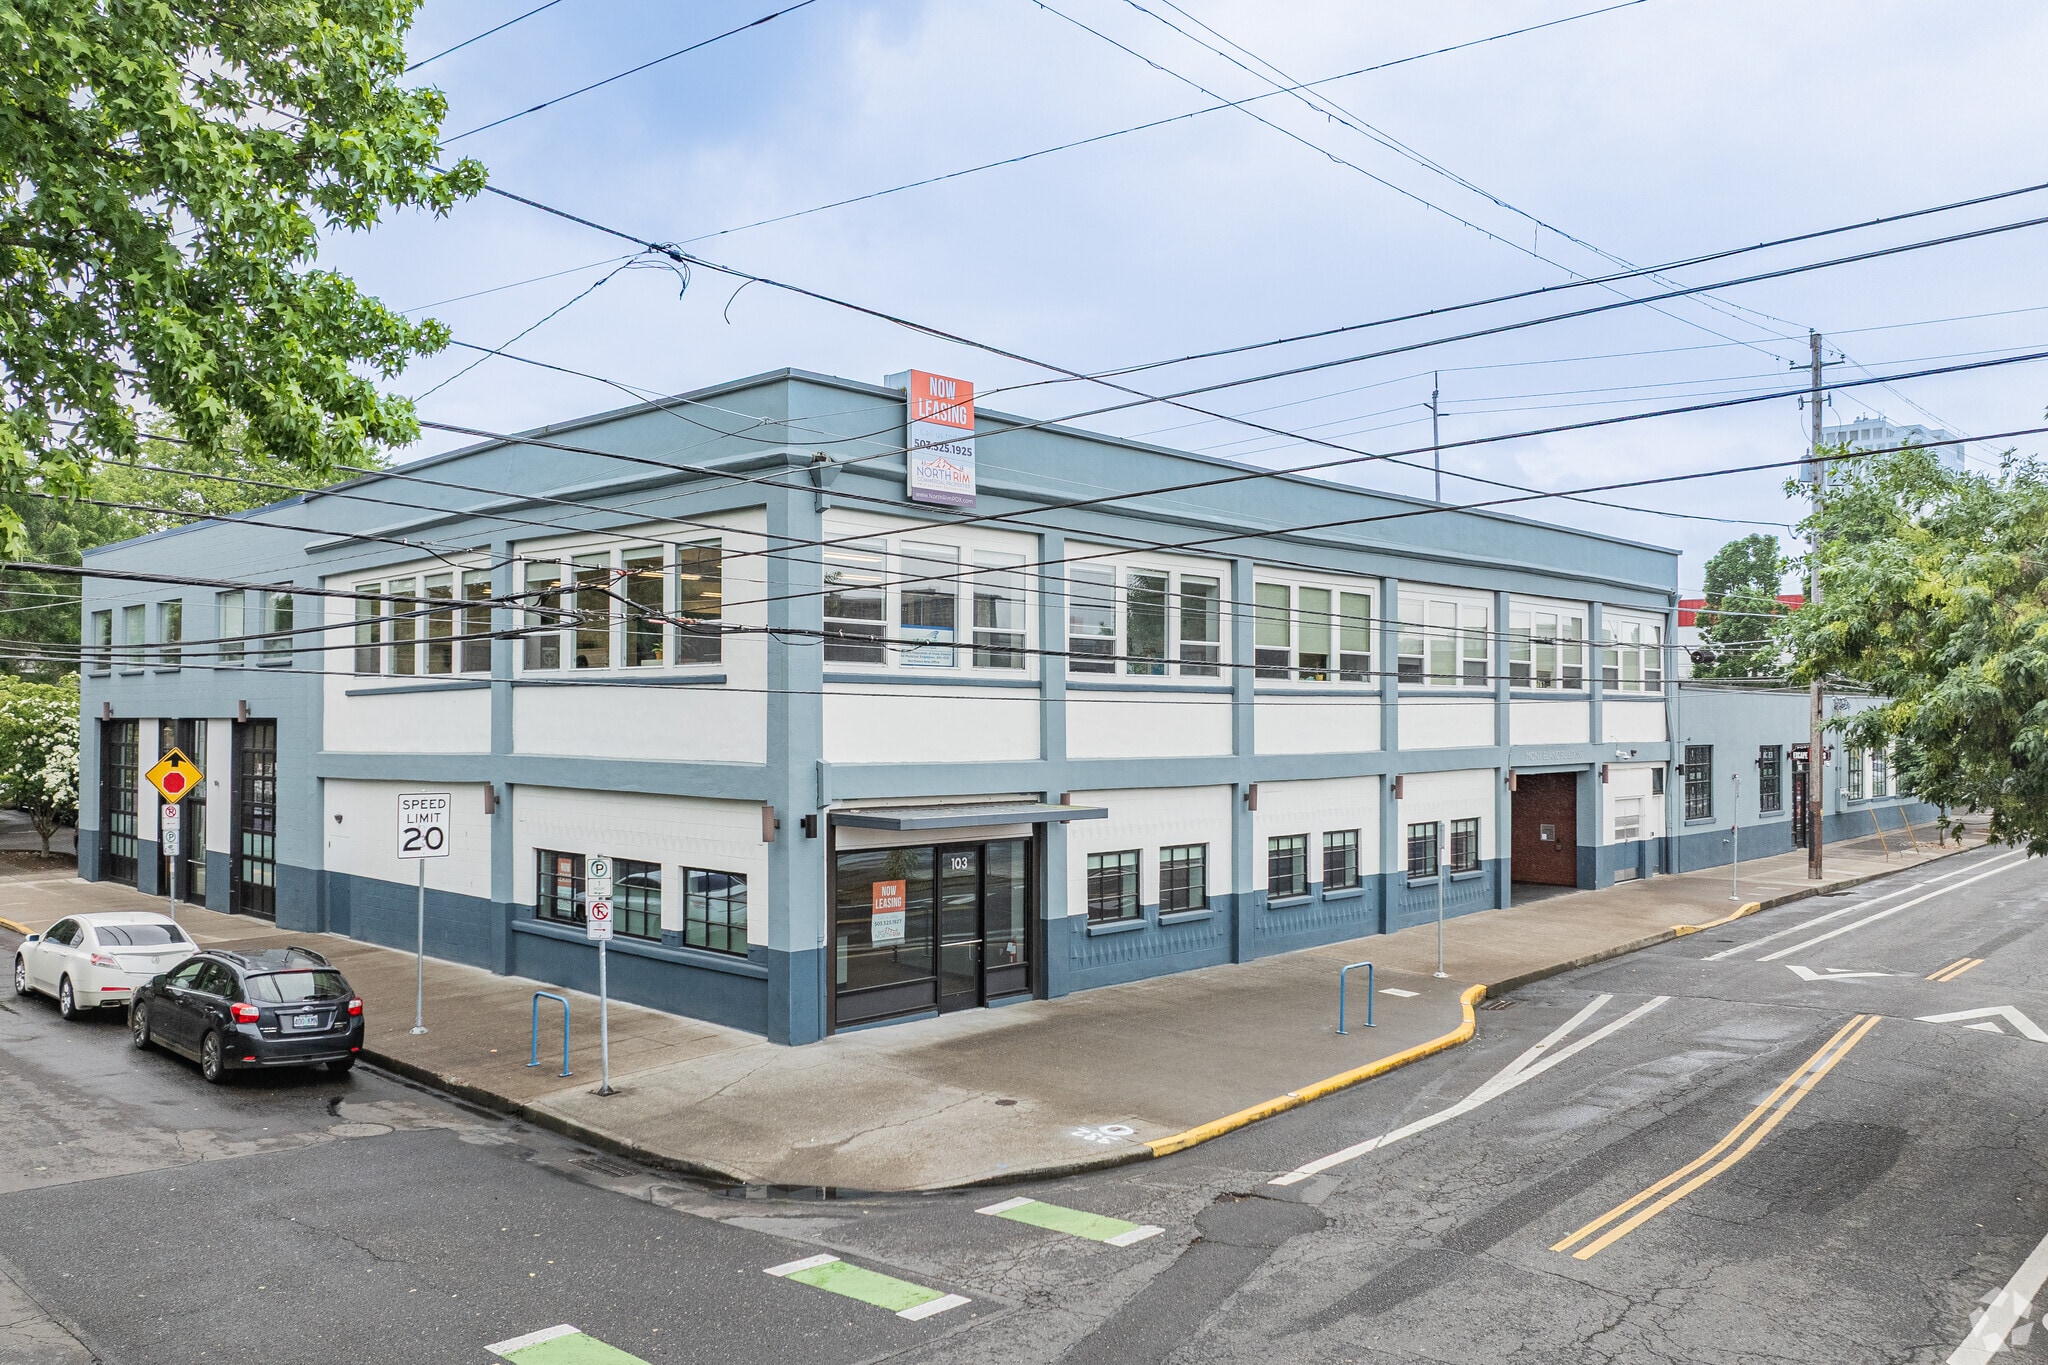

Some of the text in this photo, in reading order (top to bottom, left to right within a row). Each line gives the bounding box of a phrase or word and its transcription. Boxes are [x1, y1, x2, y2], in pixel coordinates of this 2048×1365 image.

[930, 377, 956, 400] NOW
[918, 398, 967, 425] LEASING
[916, 466, 970, 484] NORTH RIM
[402, 799, 446, 810] SPEED
[407, 812, 441, 823] LIMIT
[402, 826, 444, 852] 20
[595, 863, 604, 874] P
[951, 857, 968, 870] 103
[881, 885, 897, 896] NOW
[875, 896, 902, 910] LEASING
